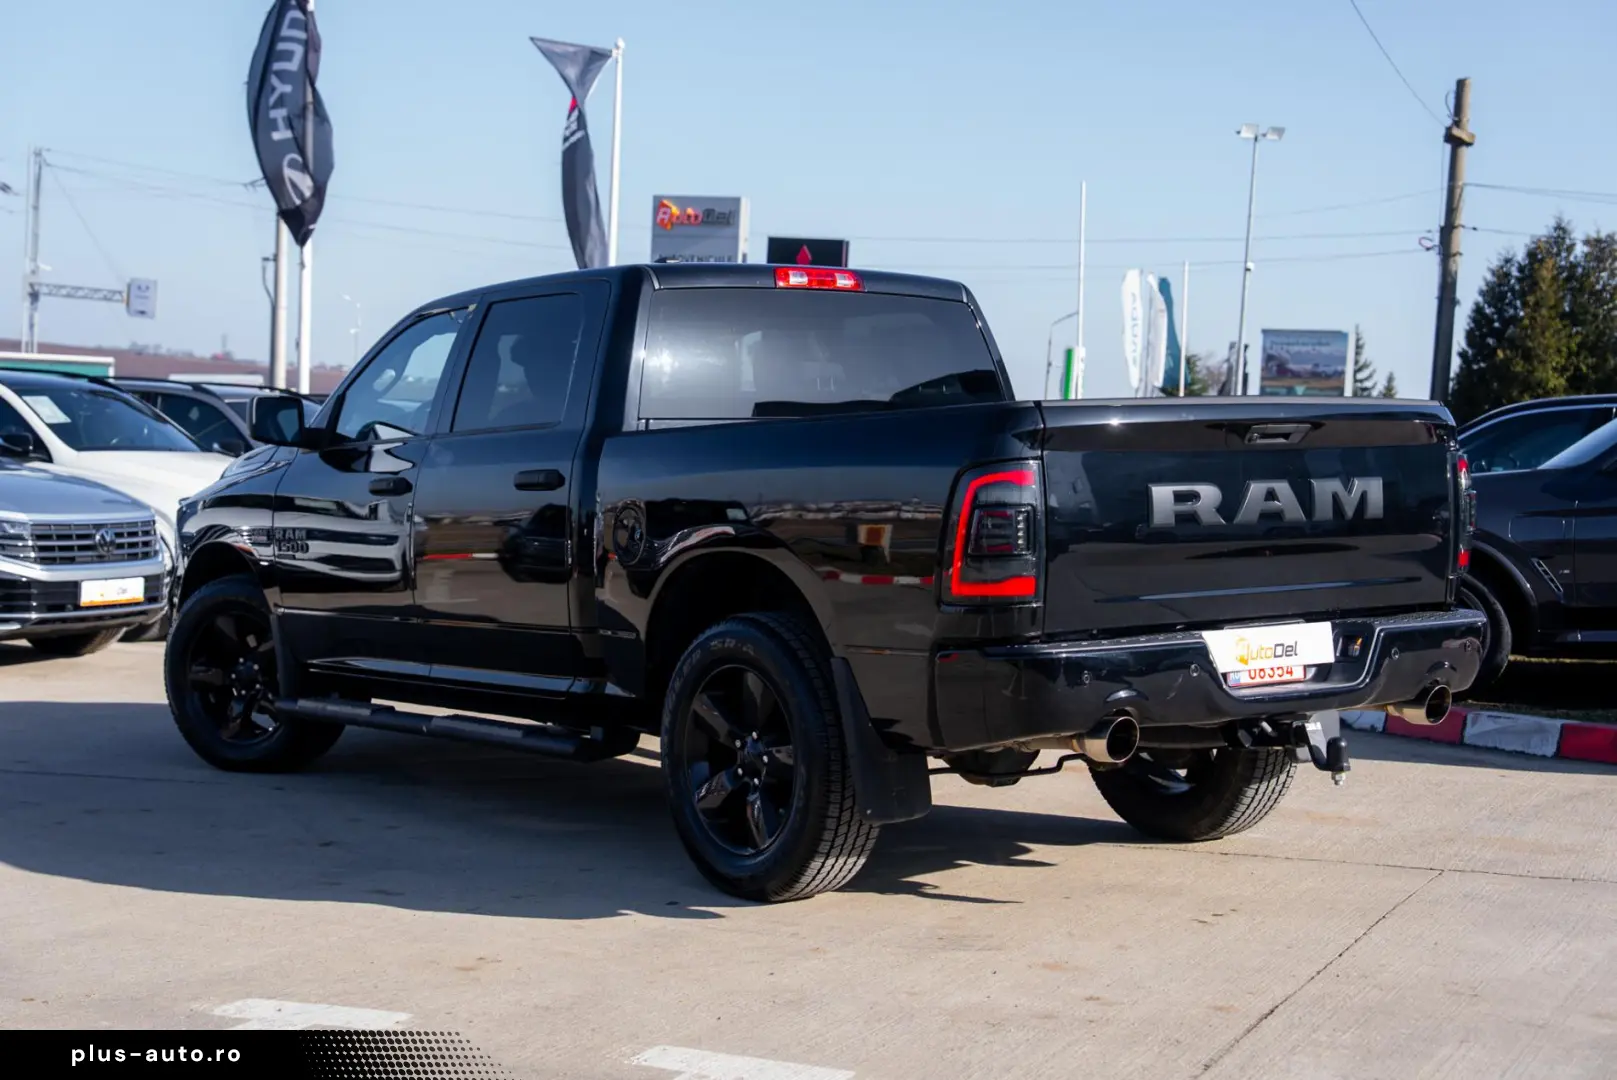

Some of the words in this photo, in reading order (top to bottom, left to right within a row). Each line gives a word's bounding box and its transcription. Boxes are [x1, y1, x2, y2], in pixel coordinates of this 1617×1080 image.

[269, 0, 308, 141] HYUND
[1148, 477, 1384, 527] RAM
[275, 528, 306, 540] RAM
